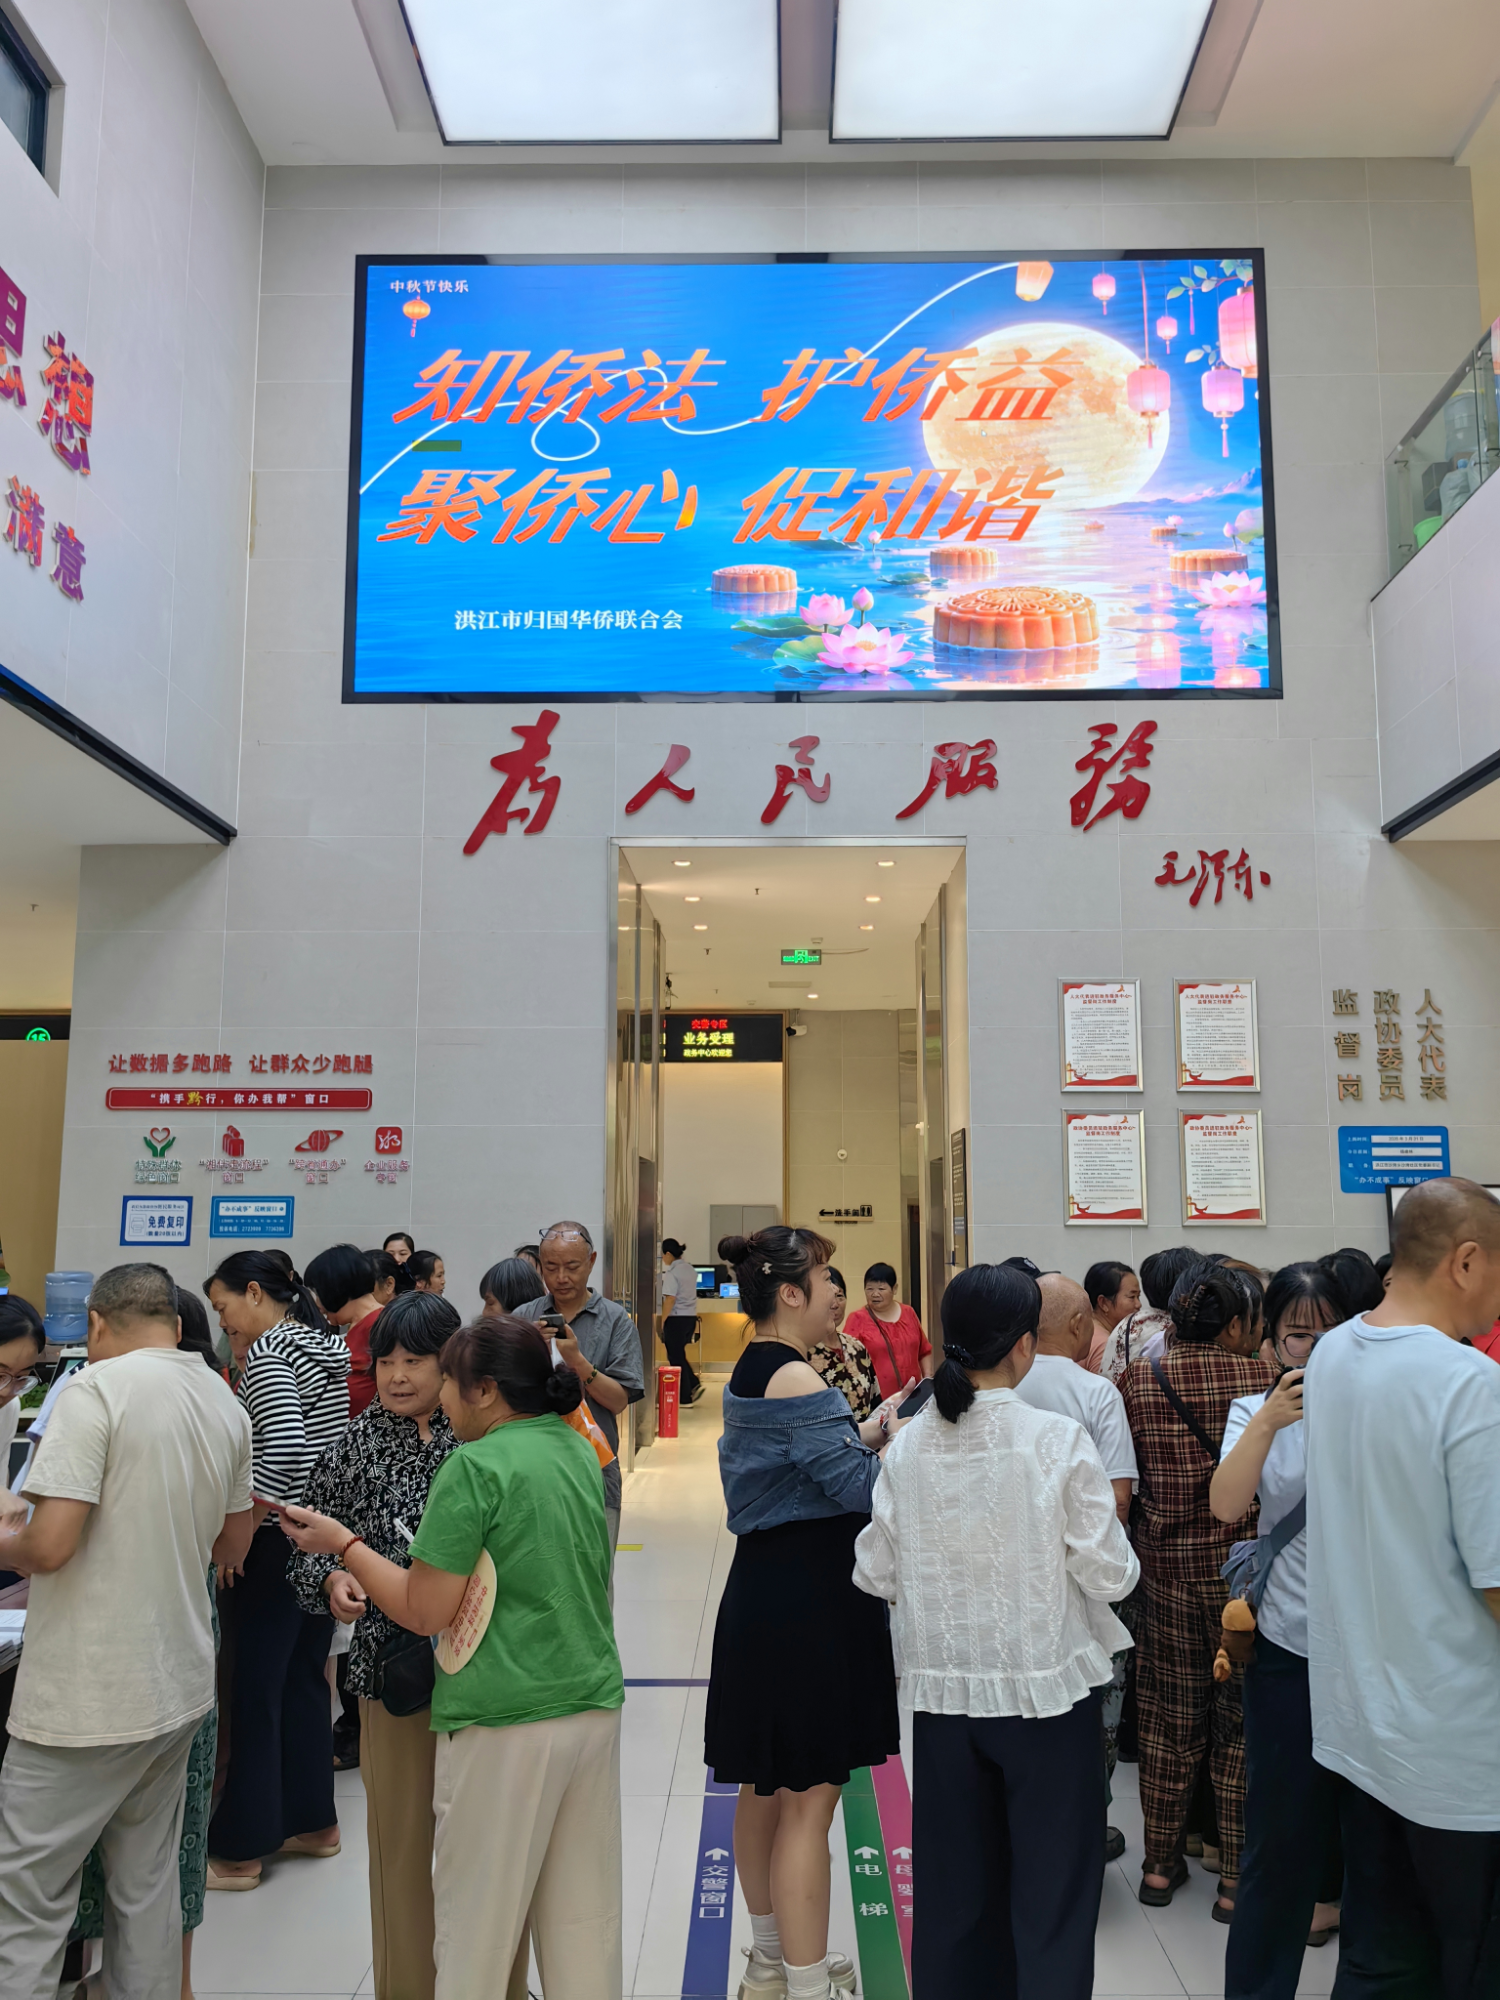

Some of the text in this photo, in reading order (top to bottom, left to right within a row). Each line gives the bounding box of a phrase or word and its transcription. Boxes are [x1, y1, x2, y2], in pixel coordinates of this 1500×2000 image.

[389, 280, 469, 293] 中秋节快乐
[392, 347, 1084, 424] 知侨法 护侨益
[376, 466, 1065, 544] 聚侨心 促和谐
[454, 609, 684, 630] 洪江市归国华侨联合会
[108, 1053, 373, 1074] 让数据多跑路 让群众少跑腿
[683, 1032, 735, 1045] 业务受理
[1332, 988, 1363, 1101] 监督岗
[1373, 988, 1405, 1101] 政协委员
[1415, 988, 1447, 1101] 人大代表
[148, 1215, 185, 1229] 免费复印
[699, 1864, 729, 1918] 交警窗口
[855, 1863, 889, 1917] 电梯
